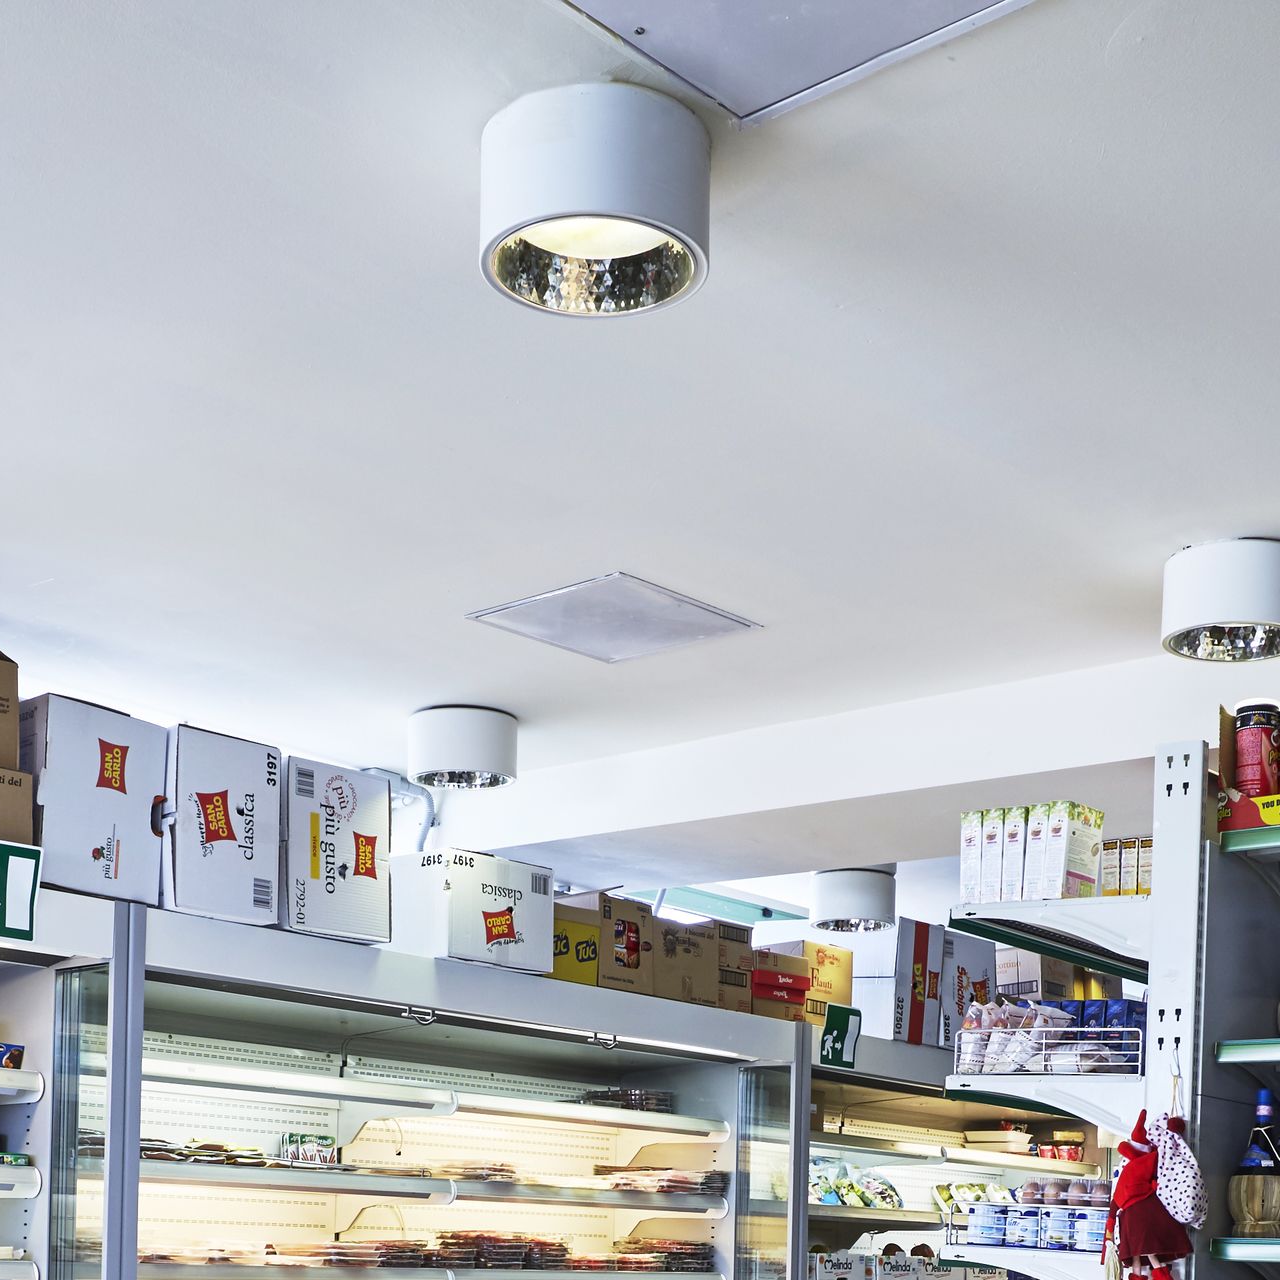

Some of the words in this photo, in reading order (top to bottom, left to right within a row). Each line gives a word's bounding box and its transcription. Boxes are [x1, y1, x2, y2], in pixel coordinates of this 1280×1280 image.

[104, 752, 113, 779] SAN
[112, 747, 122, 788] CARLO
[267, 752, 277, 787] 3197
[7, 777, 22, 788] del
[206, 804, 217, 831] SAN
[215, 796, 228, 837] CARLO
[1261, 800, 1275, 810] YOU
[238, 793, 254, 861] classica
[320, 840, 336, 895] gusto
[358, 837, 366, 874] CARLO
[363, 845, 372, 869] SAN
[421, 854, 443, 868] 3197
[453, 854, 475, 868] 3197
[295, 878, 306, 926] 2792-01
[481, 882, 523, 906] classica
[487, 915, 512, 928] CARLO
[576, 943, 597, 960] TUC
[955, 965, 969, 1017] Sunchips
[894, 996, 905, 1036] 327501
[943, 1014, 951, 1042] 3208
[824, 1258, 853, 1270] Melinda
[883, 1261, 911, 1273] Melinda
